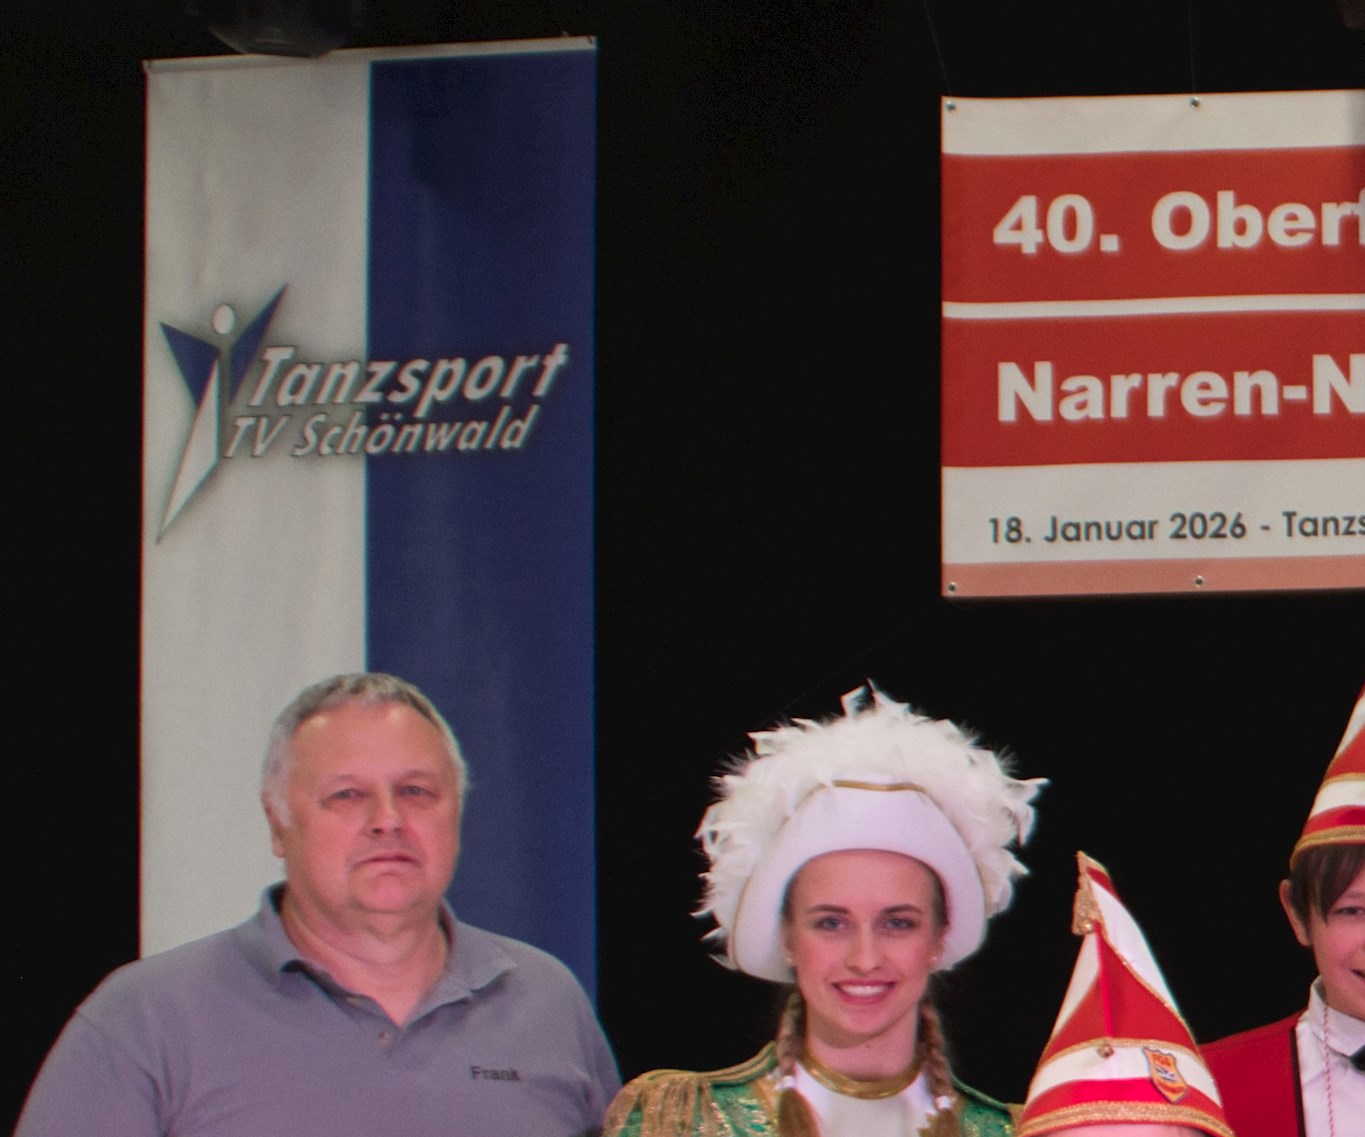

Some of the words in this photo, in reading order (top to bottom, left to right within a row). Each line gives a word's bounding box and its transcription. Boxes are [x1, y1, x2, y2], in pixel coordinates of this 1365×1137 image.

[991, 192, 1122, 256] 40.
[248, 342, 569, 417] Tanzsport
[222, 415, 290, 459] TV
[290, 403, 541, 458] Schönwald
[988, 515, 1032, 545] 18.
[1043, 515, 1160, 544] Januar
[1168, 511, 1248, 541] 2026
[469, 1065, 522, 1081] Frank
